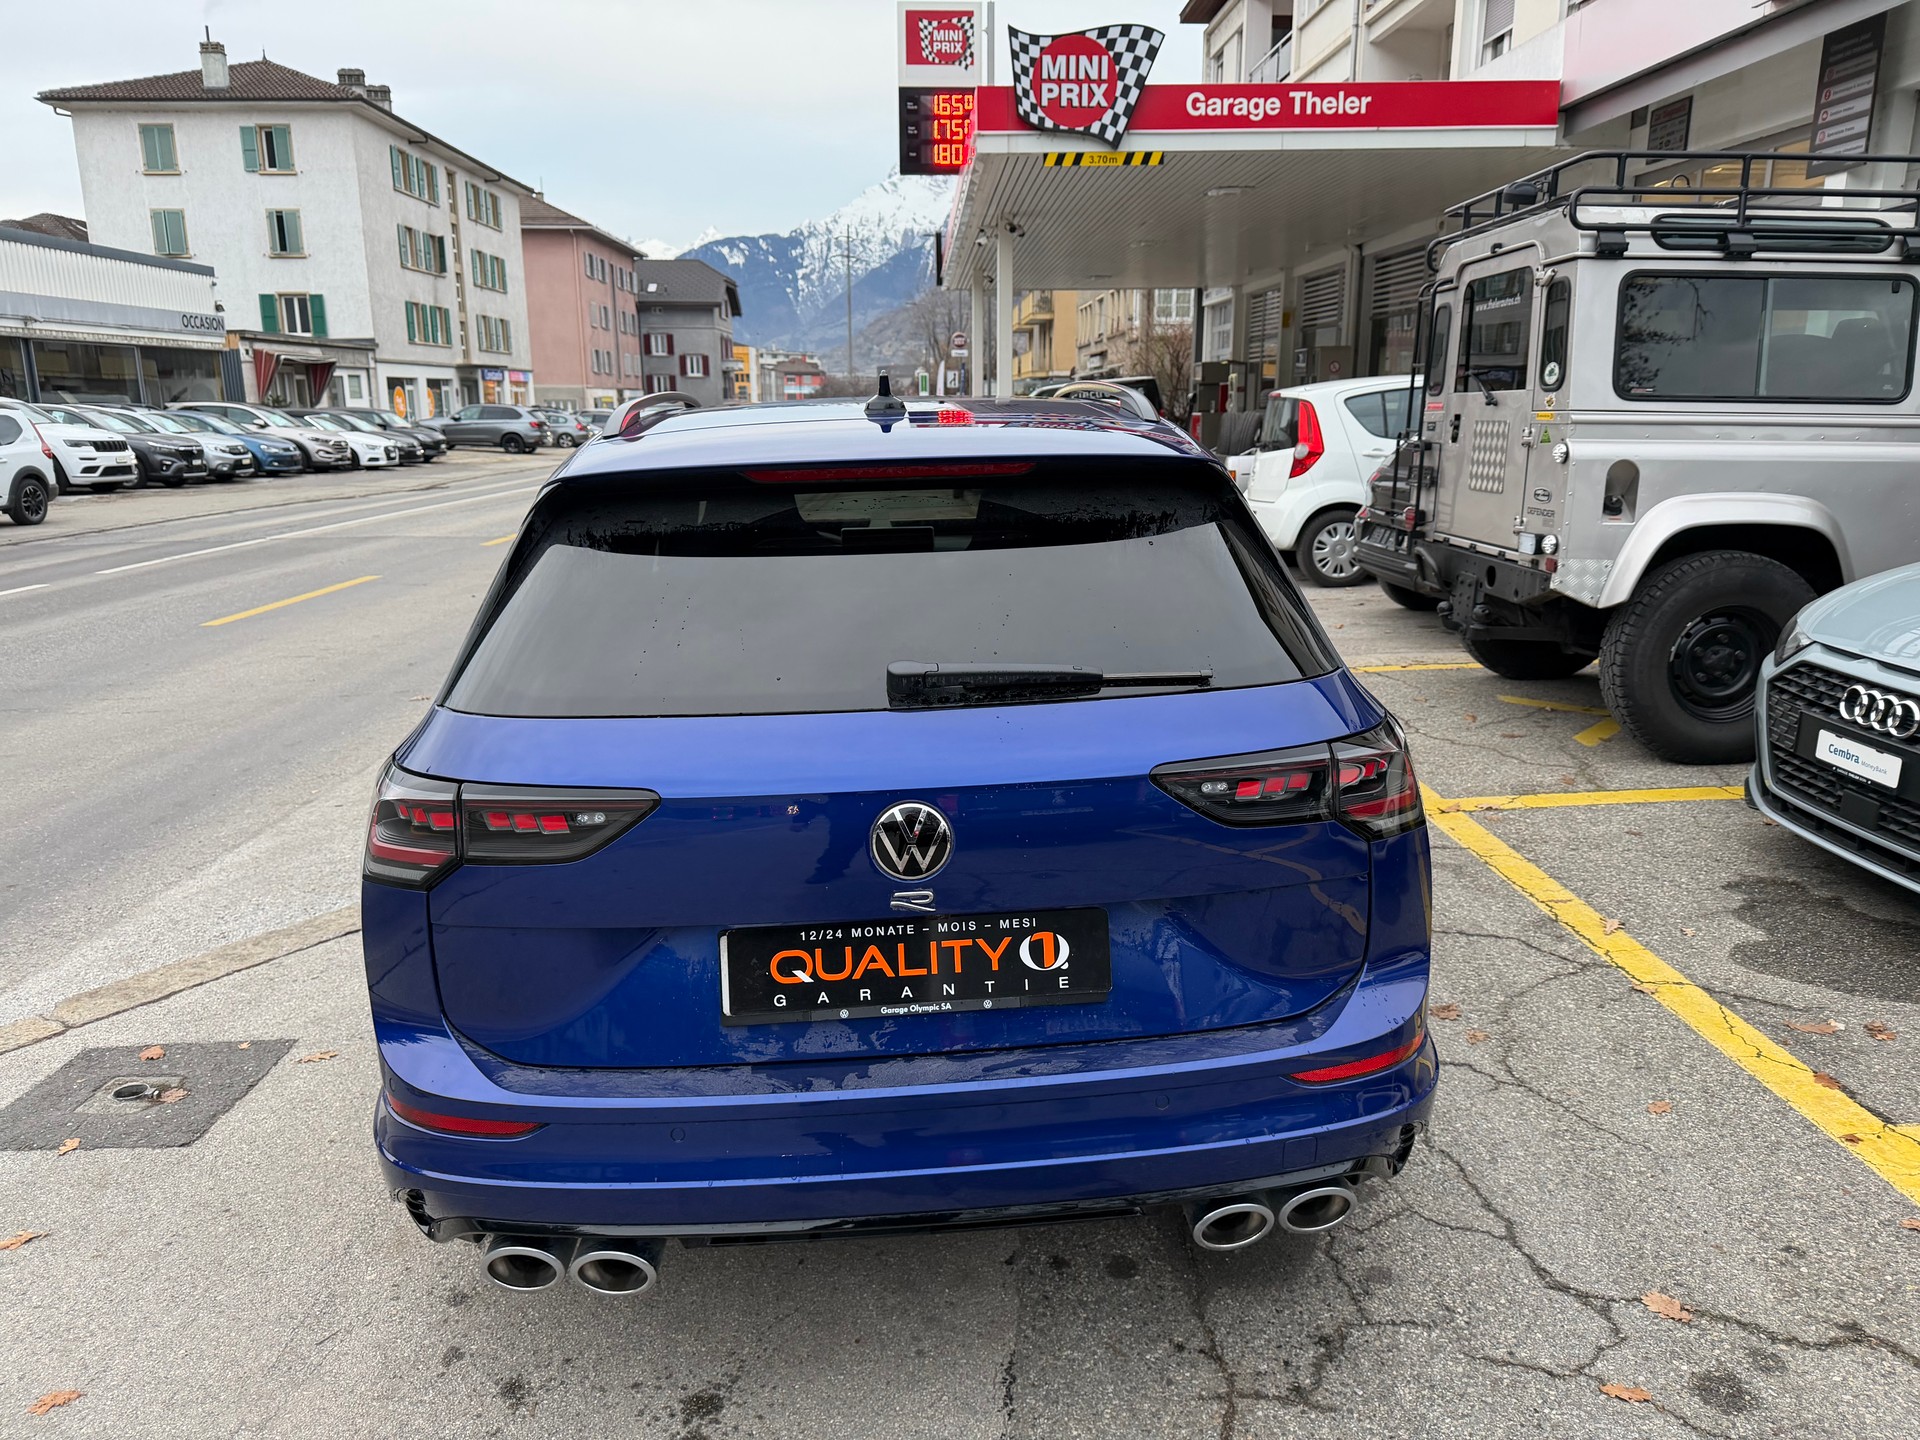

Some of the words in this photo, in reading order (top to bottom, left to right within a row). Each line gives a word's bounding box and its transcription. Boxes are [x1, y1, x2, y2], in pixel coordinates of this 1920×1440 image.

[933, 29, 963, 41] MINI
[933, 42, 963, 54] PRIX
[1041, 54, 1109, 80] MINI
[1041, 82, 1109, 108] PRIX
[1186, 91, 1281, 121] Garage
[1289, 90, 1372, 115] Theler
[181, 314, 225, 331] OCCASION
[1828, 743, 1860, 765] Cembra
[800, 929, 843, 941] 12/24
[851, 924, 915, 939] MONATE
[937, 921, 977, 933] MOIS
[999, 917, 1037, 930] MESI
[770, 936, 1013, 984] QUALITY
[880, 1006, 909, 1015] Garage
[909, 1003, 940, 1013] Olympic
[940, 1002, 952, 1010] SA
